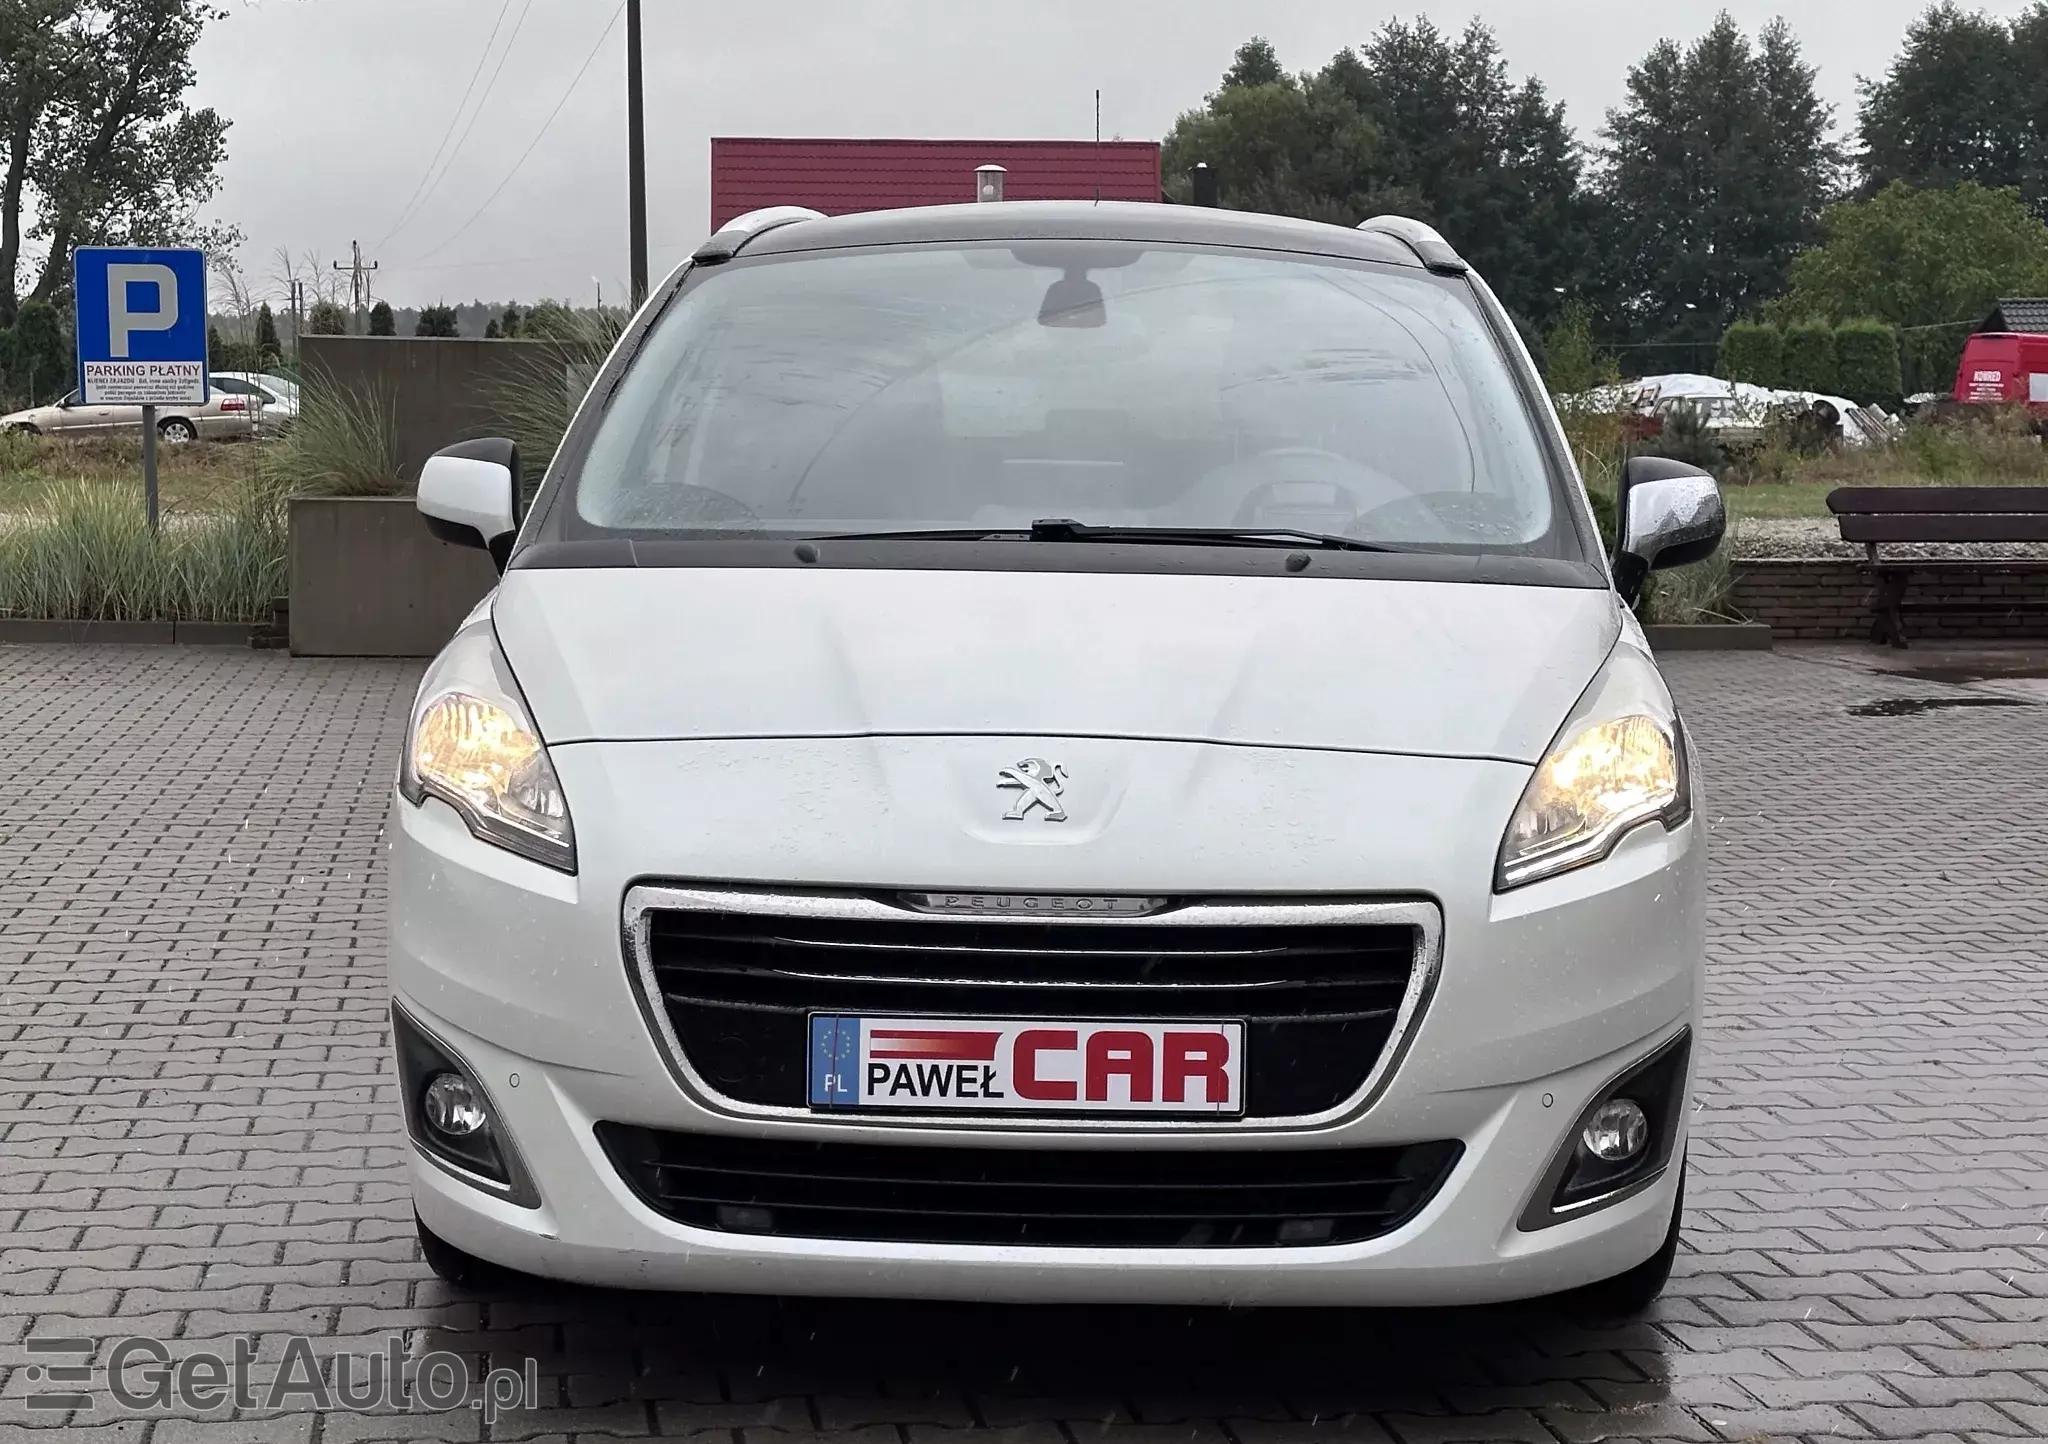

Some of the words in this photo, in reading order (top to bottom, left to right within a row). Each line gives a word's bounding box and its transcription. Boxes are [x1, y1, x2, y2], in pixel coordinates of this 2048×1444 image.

[107, 263, 178, 357] P
[86, 365, 145, 376] PARKING
[150, 365, 200, 376] PŁATNY
[944, 895, 1118, 911] PEUGEOT
[867, 1062, 1005, 1098] PAWEŁ
[1013, 1029, 1230, 1103] CAR
[824, 1073, 848, 1093] PL
